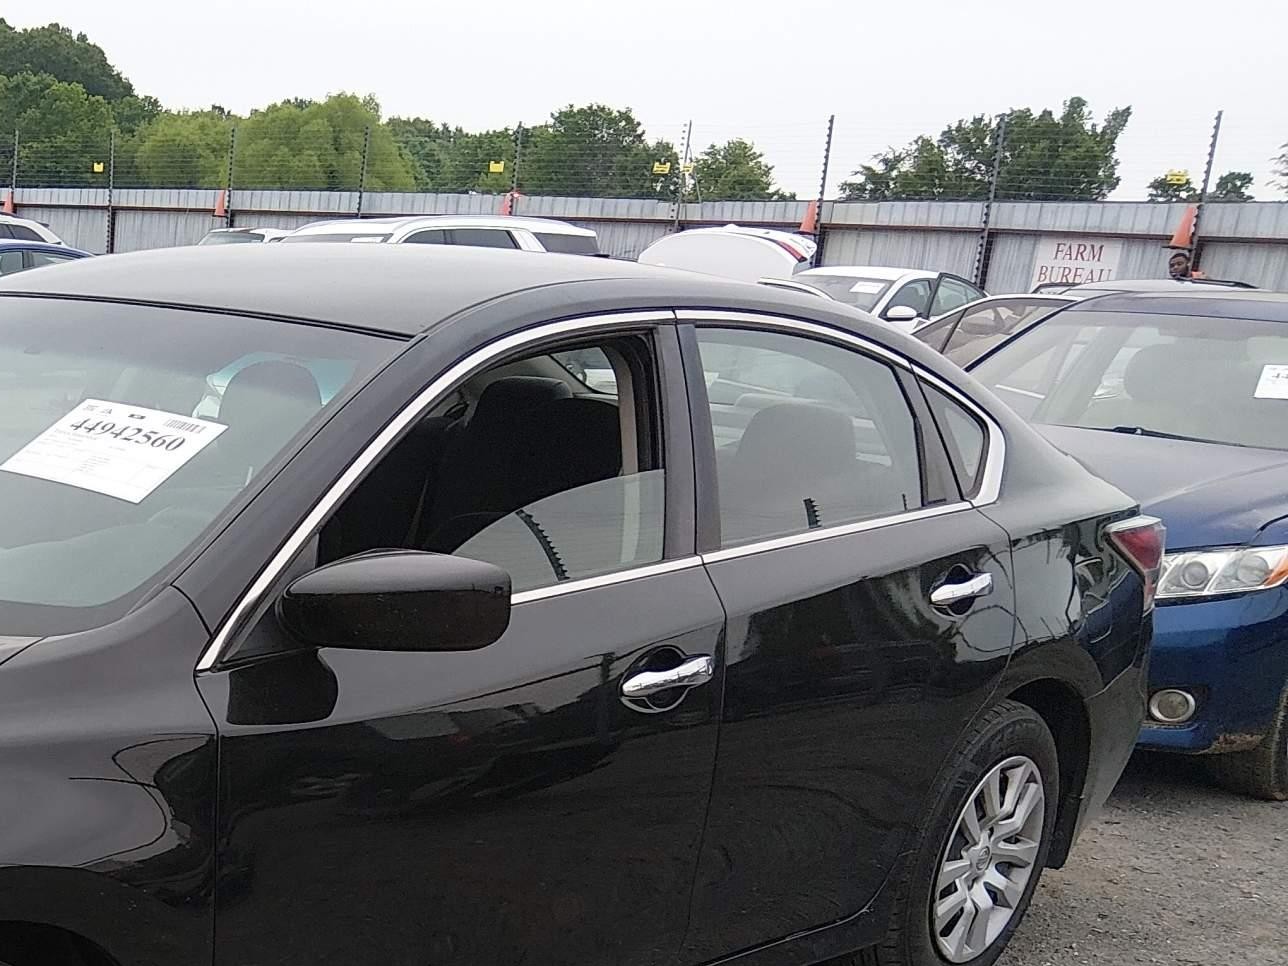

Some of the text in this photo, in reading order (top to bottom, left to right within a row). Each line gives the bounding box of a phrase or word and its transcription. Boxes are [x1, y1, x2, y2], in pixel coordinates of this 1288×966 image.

[1054, 242, 1105, 262] FARM
[1037, 265, 1113, 283] BUREAU
[69, 417, 187, 452] 44942560
